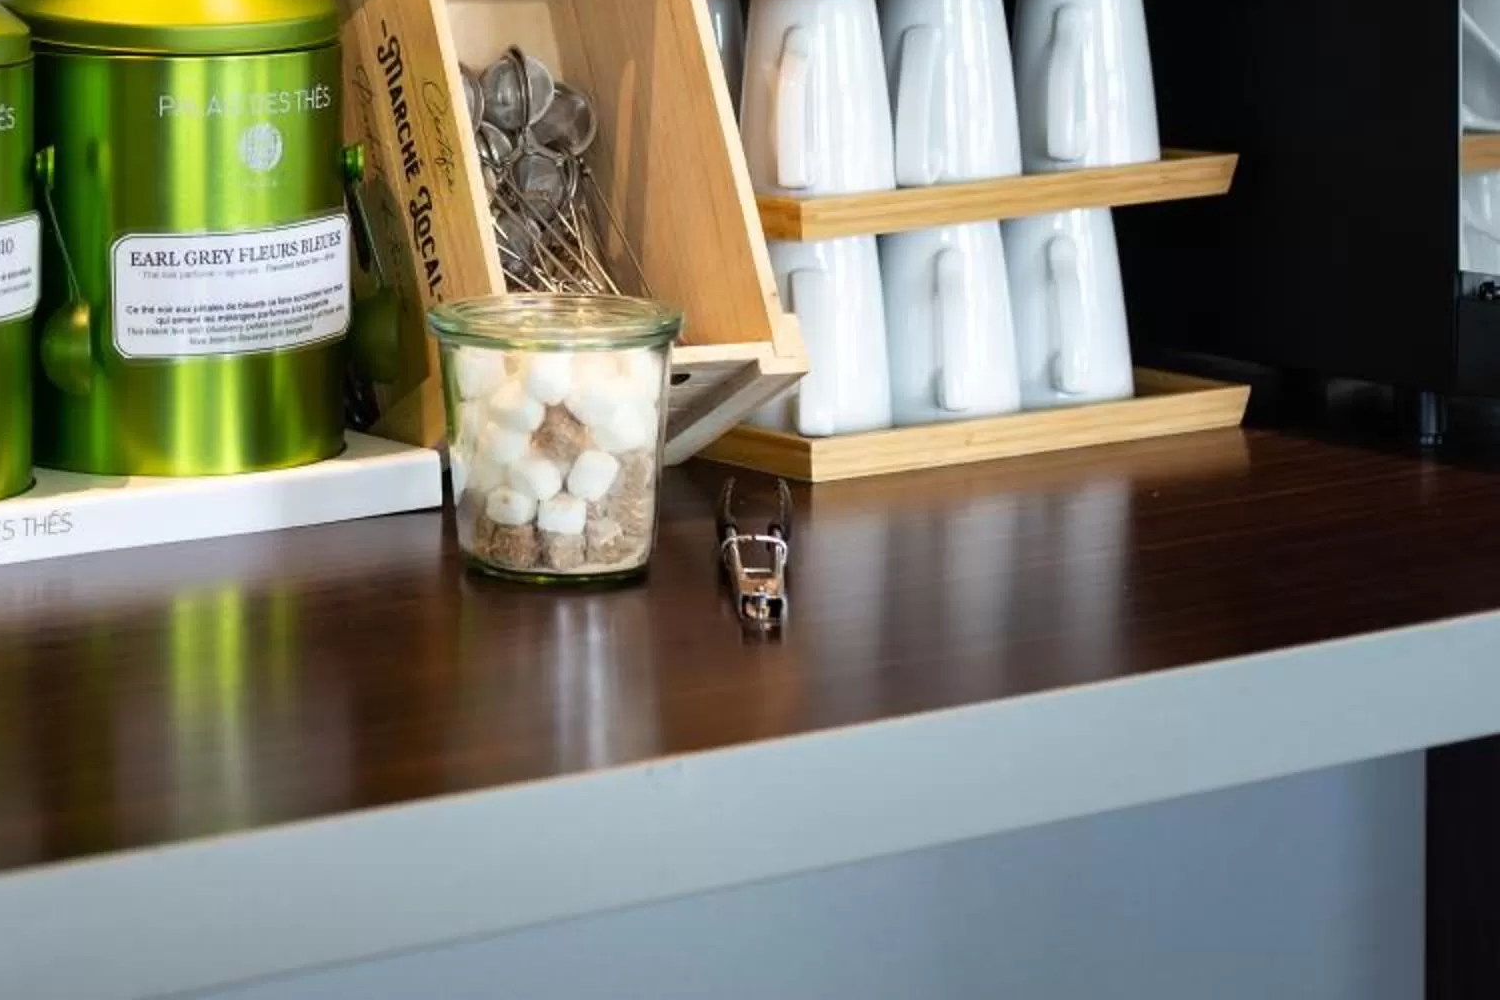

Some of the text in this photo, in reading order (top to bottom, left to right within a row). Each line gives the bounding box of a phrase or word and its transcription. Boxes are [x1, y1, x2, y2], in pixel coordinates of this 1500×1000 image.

[159, 93, 242, 118] PAIS
[294, 83, 332, 113] THÉS
[131, 250, 180, 267] EARL
[183, 247, 235, 266] GREY
[238, 240, 299, 262] FLEURS
[301, 229, 341, 254] BLEUES
[22, 509, 74, 537] THÉS
